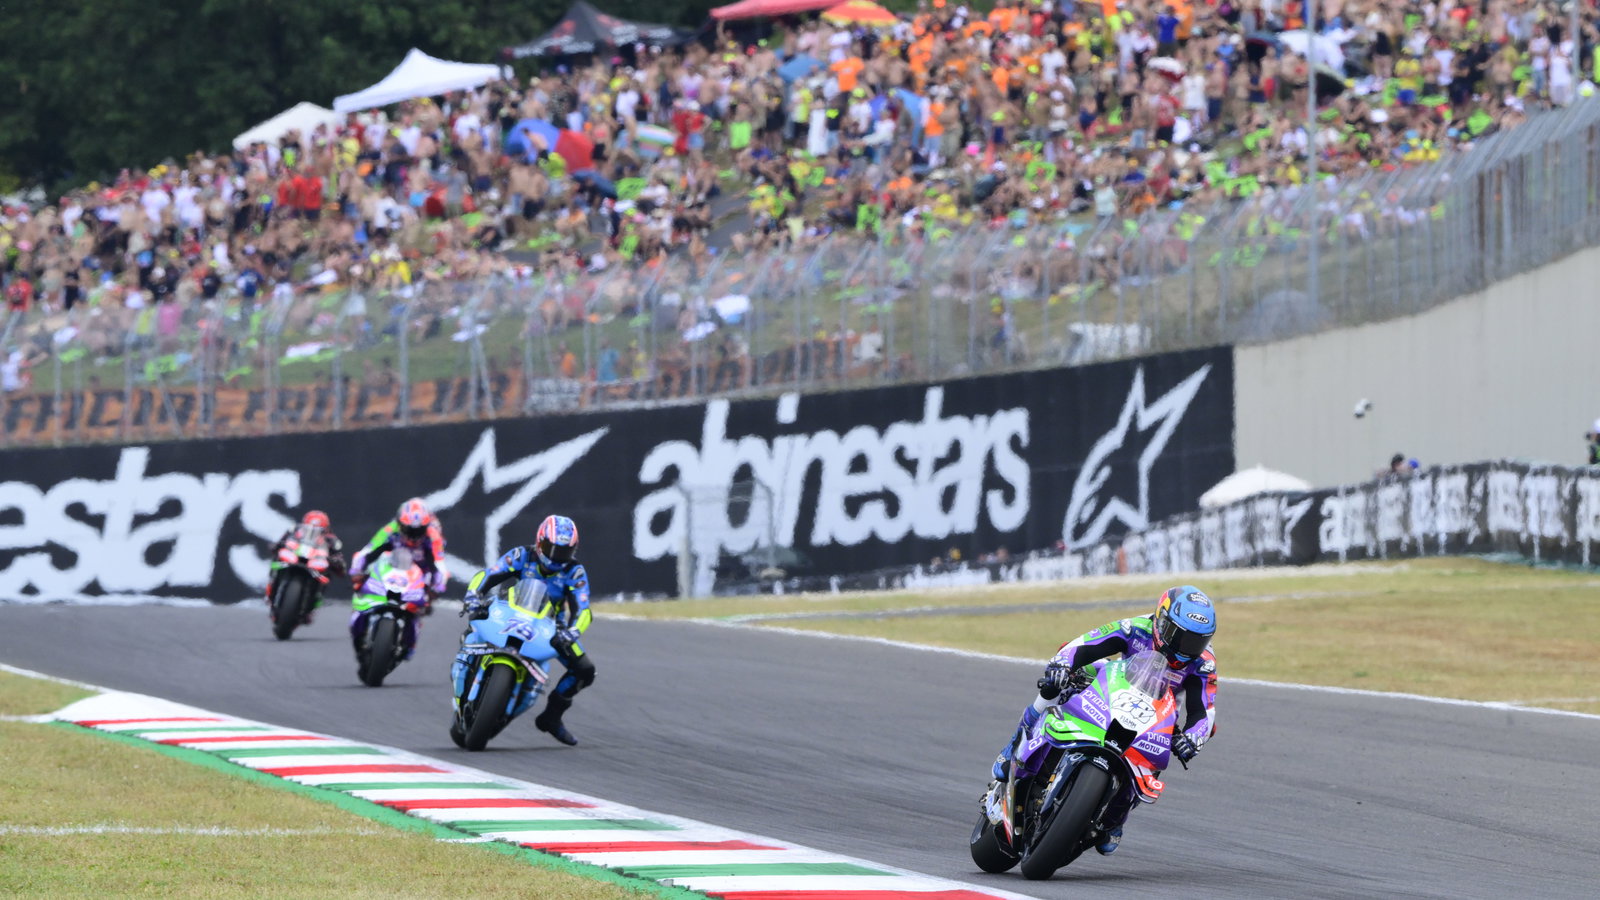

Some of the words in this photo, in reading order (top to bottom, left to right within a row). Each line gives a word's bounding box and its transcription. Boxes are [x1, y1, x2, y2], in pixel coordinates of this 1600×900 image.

[632, 387, 1030, 594] alpinestars
[1083, 689, 1109, 711] prima
[1083, 703, 1106, 725] MOTUL
[1147, 731, 1171, 746] prima
[1138, 742, 1161, 754] MOTUL
[1148, 775, 1163, 789] 10
